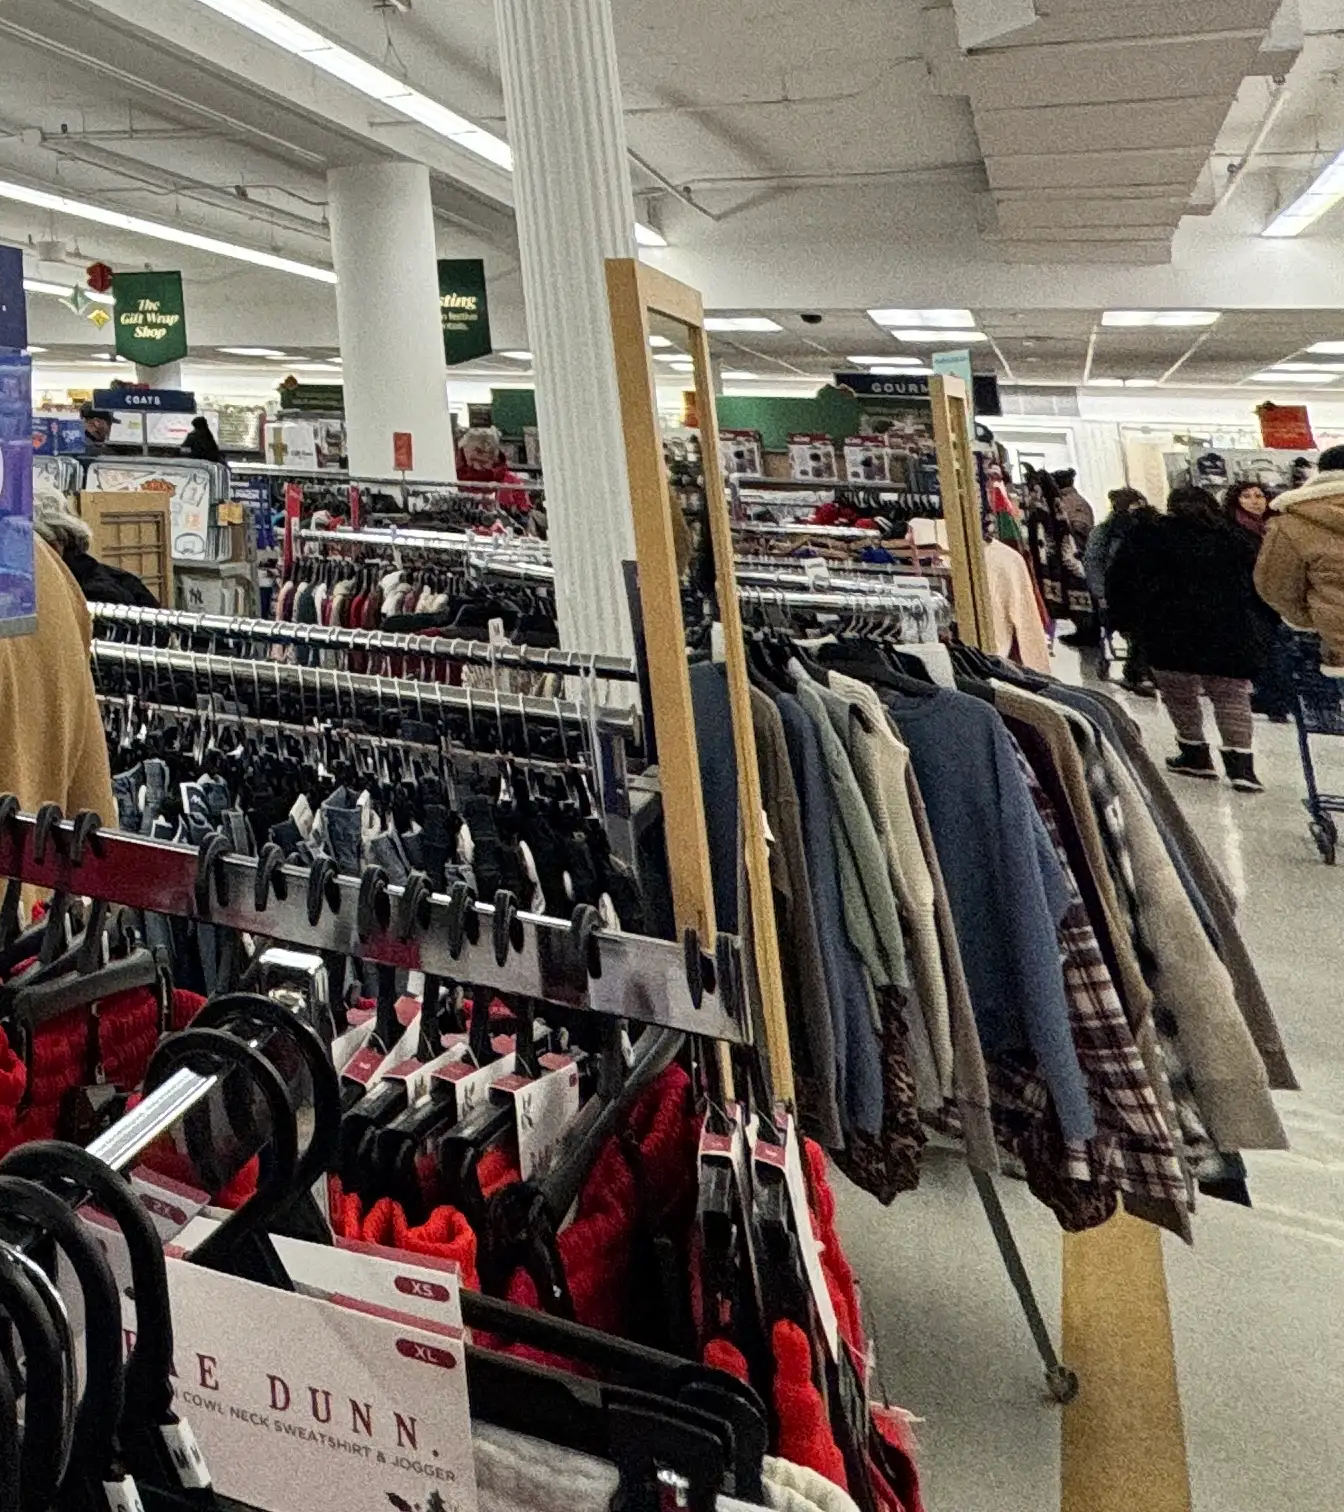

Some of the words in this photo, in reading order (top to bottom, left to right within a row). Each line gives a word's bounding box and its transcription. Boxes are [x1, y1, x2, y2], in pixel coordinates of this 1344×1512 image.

[136, 299, 161, 311] The
[120, 312, 144, 326] Gift
[146, 312, 180, 327] Wrap
[133, 325, 168, 340] Shop
[124, 395, 162, 406] COATS
[409, 1281, 434, 1297] XS
[414, 1345, 438, 1362] XL
[265, 1373, 440, 1458] DUNN.
[183, 1391, 224, 1416] COWL
[229, 1405, 269, 1429] NECK
[274, 1420, 372, 1459] SWEATSHIRT
[376, 1450, 386, 1464] &
[391, 1455, 457, 1483] JOGGER
